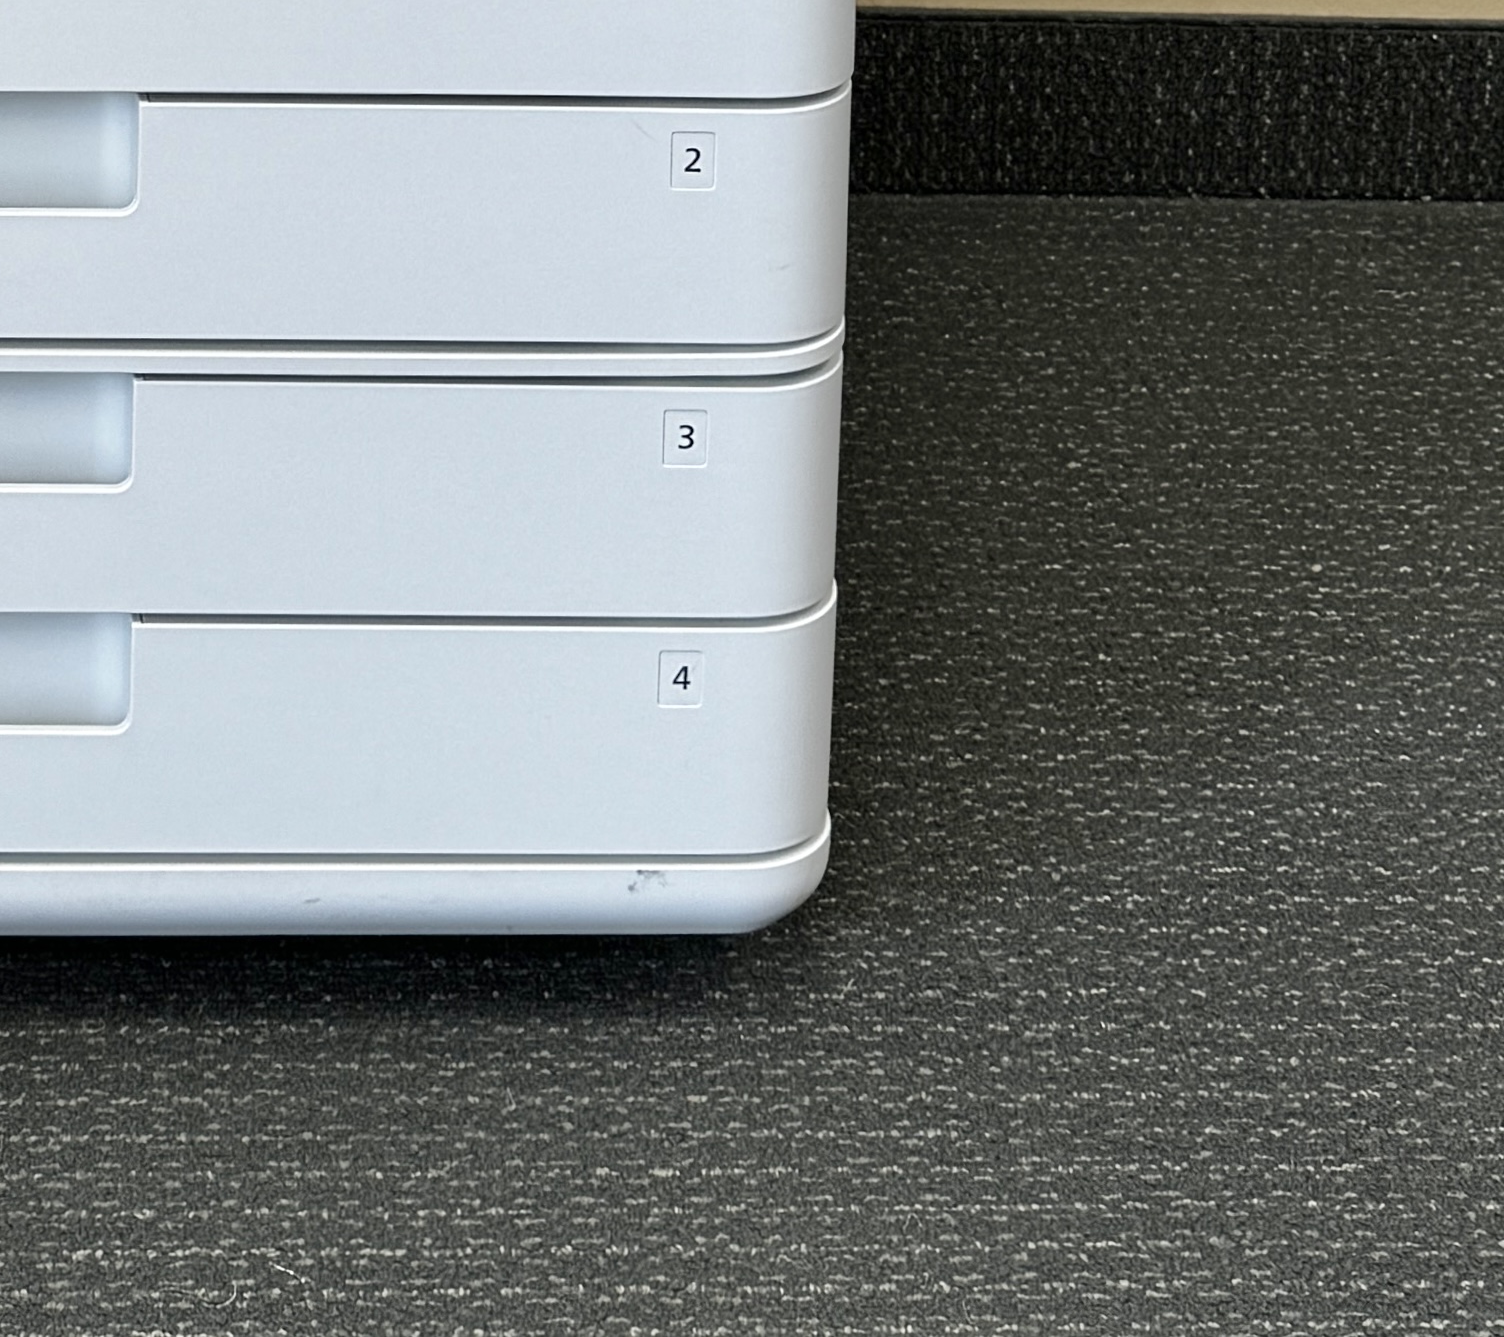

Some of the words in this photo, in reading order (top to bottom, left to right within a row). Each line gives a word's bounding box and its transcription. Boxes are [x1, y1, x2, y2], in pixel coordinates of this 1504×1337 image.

[683, 147, 702, 173] 2
[677, 424, 695, 450] 3
[671, 665, 691, 691] 4
